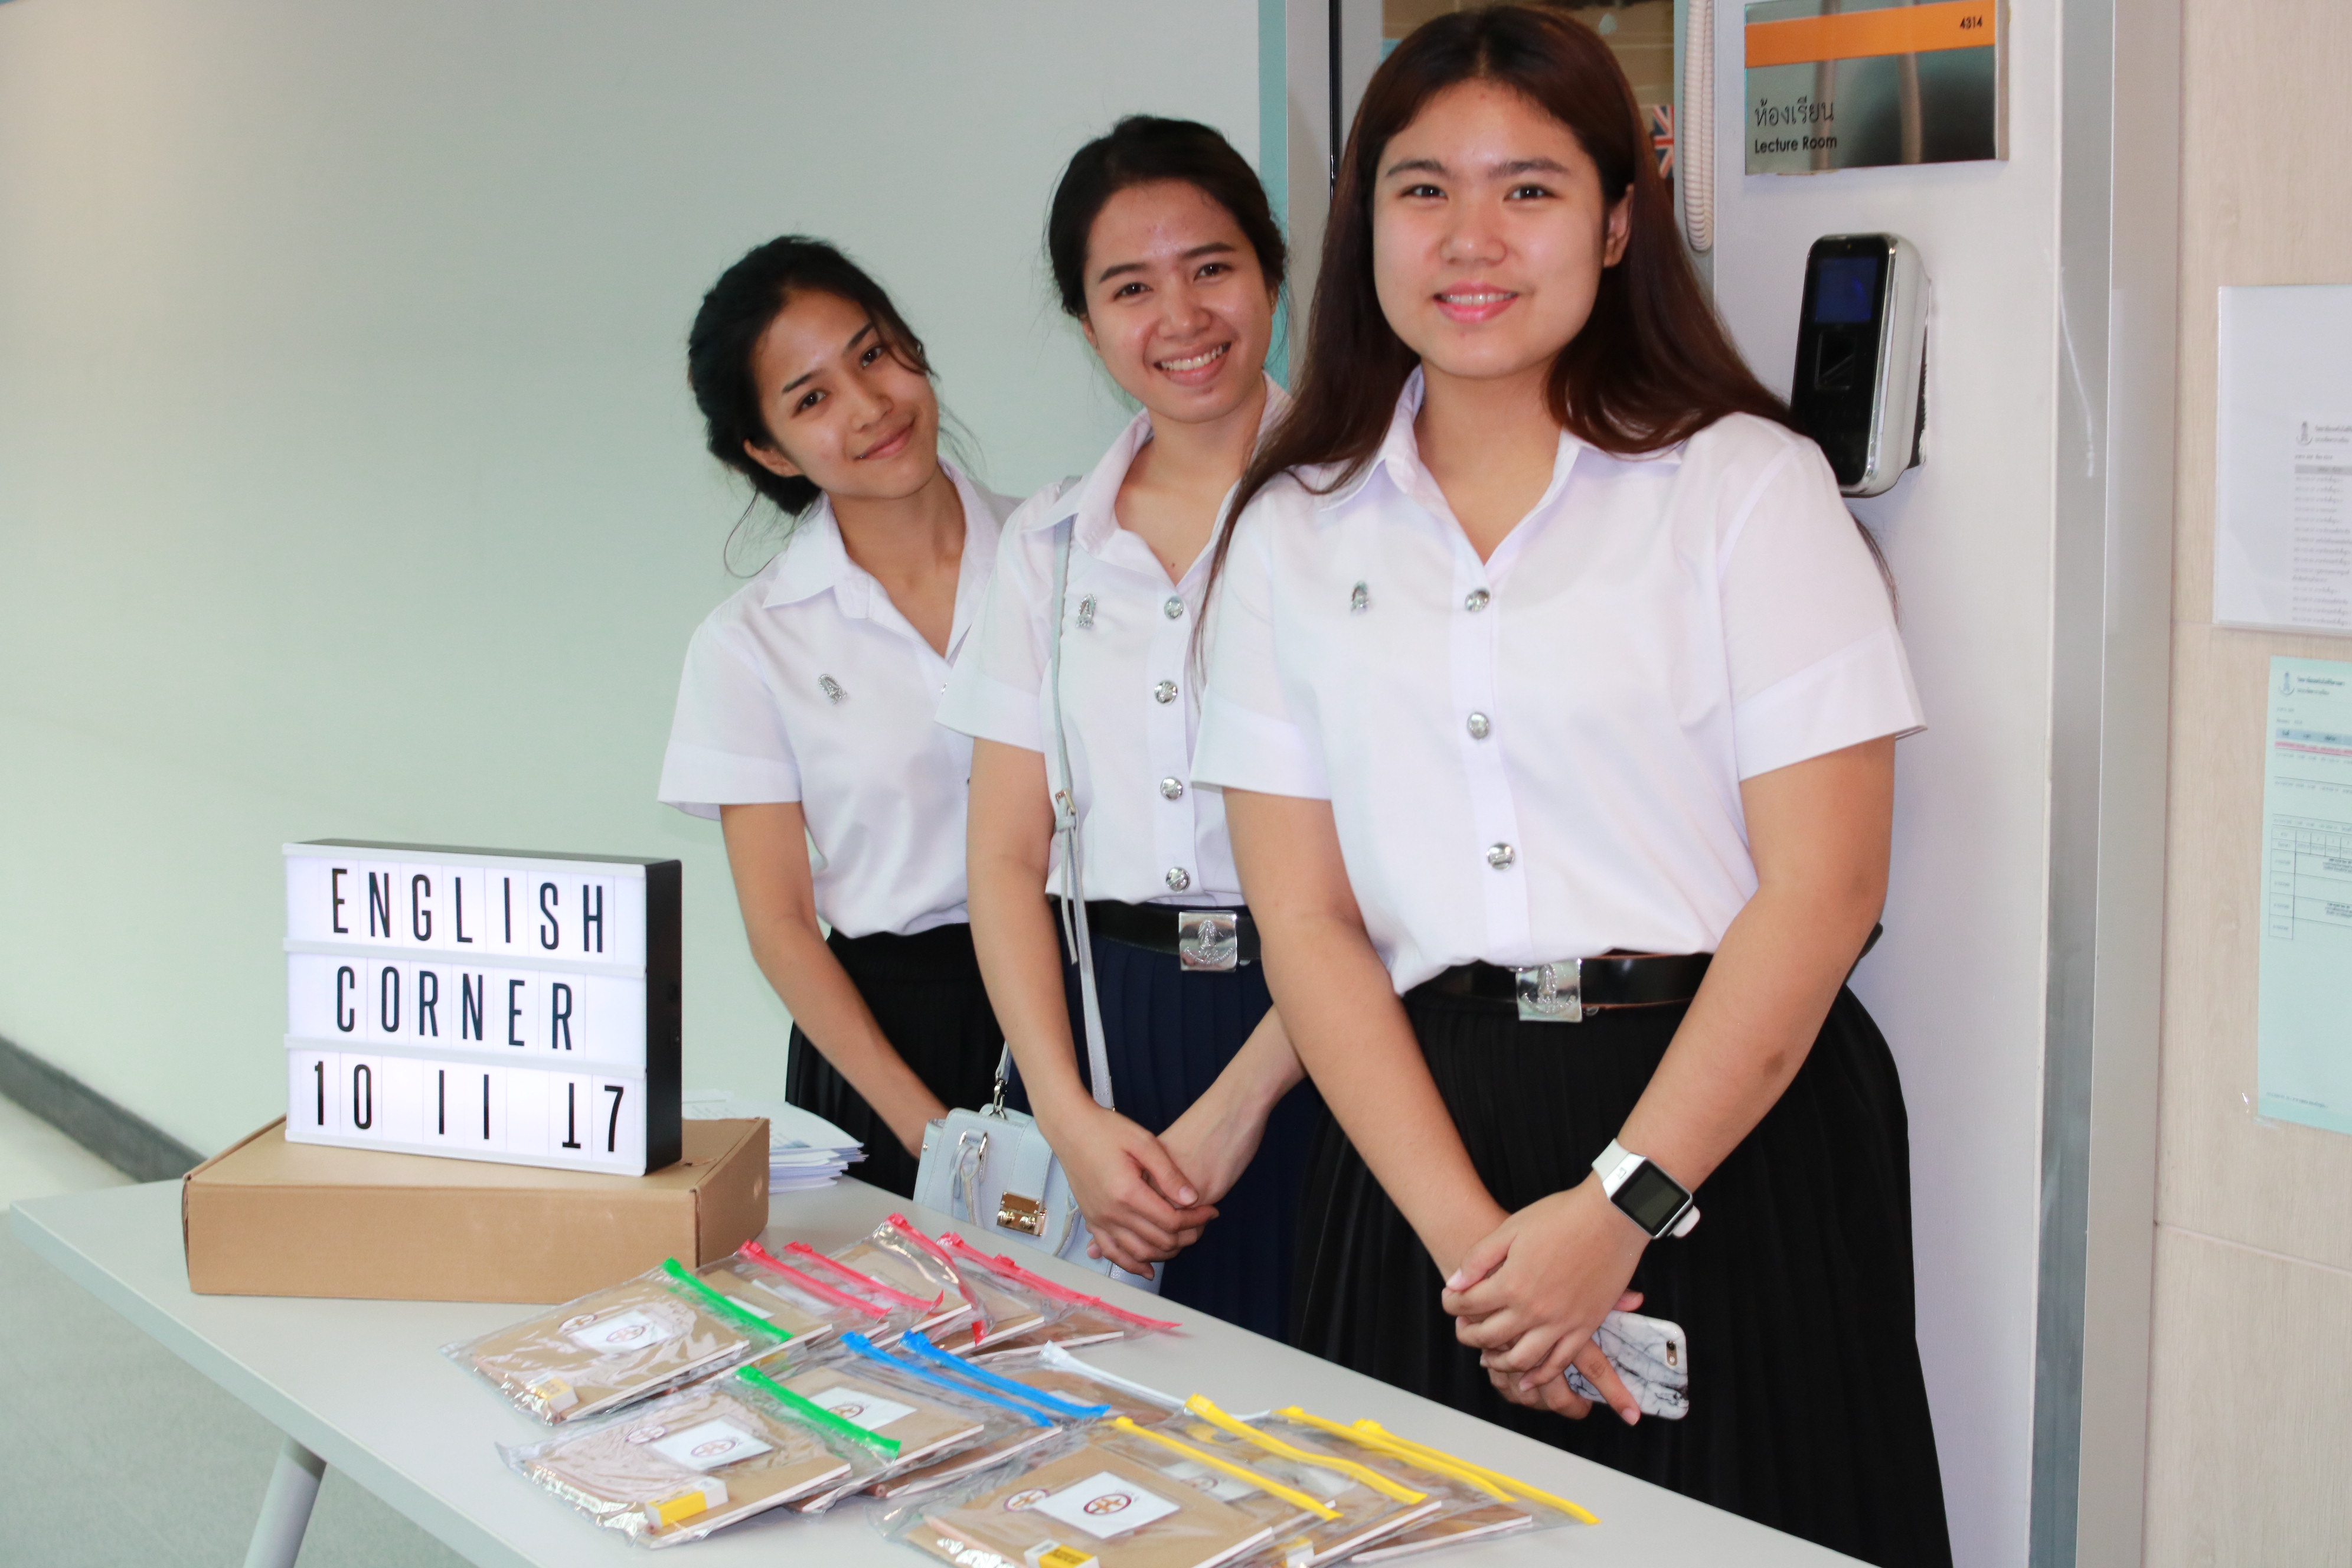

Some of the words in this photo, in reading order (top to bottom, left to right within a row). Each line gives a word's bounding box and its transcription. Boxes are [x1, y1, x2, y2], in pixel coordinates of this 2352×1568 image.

[1959, 16, 1983, 30] 4314
[1754, 95, 1835, 127] ห้องเรียน
[1755, 138, 1798, 153] Lecture
[1802, 136, 1837, 150] Room
[332, 868, 603, 953] ENGLISH
[337, 966, 573, 1050] CORNER
[314, 1060, 372, 1130] 10
